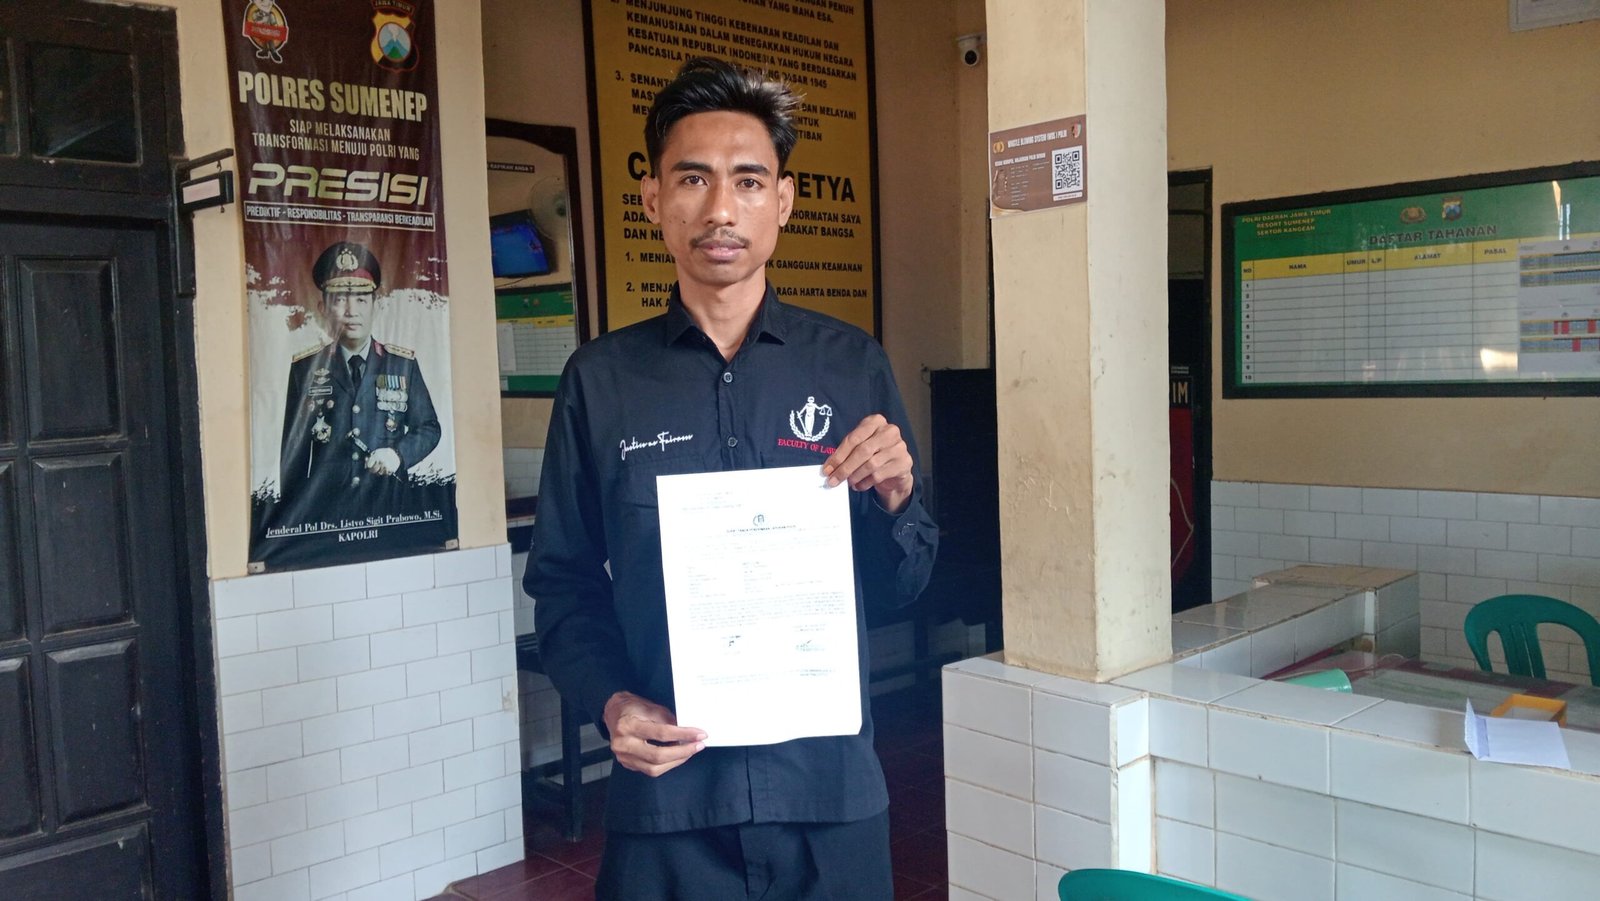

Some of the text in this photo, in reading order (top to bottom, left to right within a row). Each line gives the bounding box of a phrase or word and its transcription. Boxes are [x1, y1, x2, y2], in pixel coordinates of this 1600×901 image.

[768, 0, 789, 13] YANG
[792, 5, 814, 19] MAHA
[829, 2, 853, 15] PENUH
[626, 0, 839, 51] MENJUNJUNG TINGGI KEBENARAN KEADILAN DAN
[627, 11, 853, 67] KEMANUSIAAN DALAM MENEGAKKAN HUKUM NEGARA
[628, 27, 679, 46] KESATUAN
[682, 38, 726, 55] REPUBLIK
[729, 47, 775, 65] INDONESIA
[777, 58, 799, 70] YANG
[801, 62, 856, 81] BERDASARKAN
[628, 42, 682, 60] PANCASILA
[810, 78, 827, 88] 1945
[615, 70, 624, 81] 3.
[238, 70, 427, 122] POLRES SUMENEP
[802, 103, 818, 114] DAN
[820, 105, 856, 120] MELAYANI
[289, 119, 391, 142] SIAP MELAKSANAKAN
[252, 132, 420, 160] TRANSFORMASI MENUJU POLRI YANG
[248, 162, 429, 206] PRESISI
[246, 205, 281, 216] PREDIKTIF
[287, 208, 342, 222] RESPONSIBILITAS
[346, 211, 394, 225] TRANSPARANSI
[394, 214, 433, 227] BERKEADILAN
[789, 209, 838, 223] HORMATAN
[841, 214, 861, 224] SAYA
[1256, 218, 1315, 229] RESORT SUMENEP
[1262, 213, 1288, 221] DAERAH
[1310, 208, 1331, 216] TIMUR
[624, 228, 647, 239] DAN
[821, 227, 854, 238] BANGSA
[1369, 225, 1497, 245] DAFTAR TAHANAN
[625, 251, 634, 262] 1.
[776, 259, 819, 271] GANGGUAN
[821, 262, 862, 273] KEAMANAN
[1346, 258, 1366, 266] UMUR
[1414, 253, 1442, 261] ALAMAT
[626, 282, 635, 292] 2.
[776, 287, 798, 296] RAGA
[800, 288, 824, 297] HARTA
[827, 289, 851, 298] BENDA
[853, 289, 867, 298] DAN
[641, 298, 662, 308] HAK
[777, 438, 809, 449] FACULTY
[810, 443, 820, 452] OF
[304, 523, 318, 532] Pol
[320, 521, 338, 531] Drs.
[366, 516, 384, 527] Sigit
[424, 510, 443, 520] M.Si.
[338, 529, 378, 542] KAPOLRI
